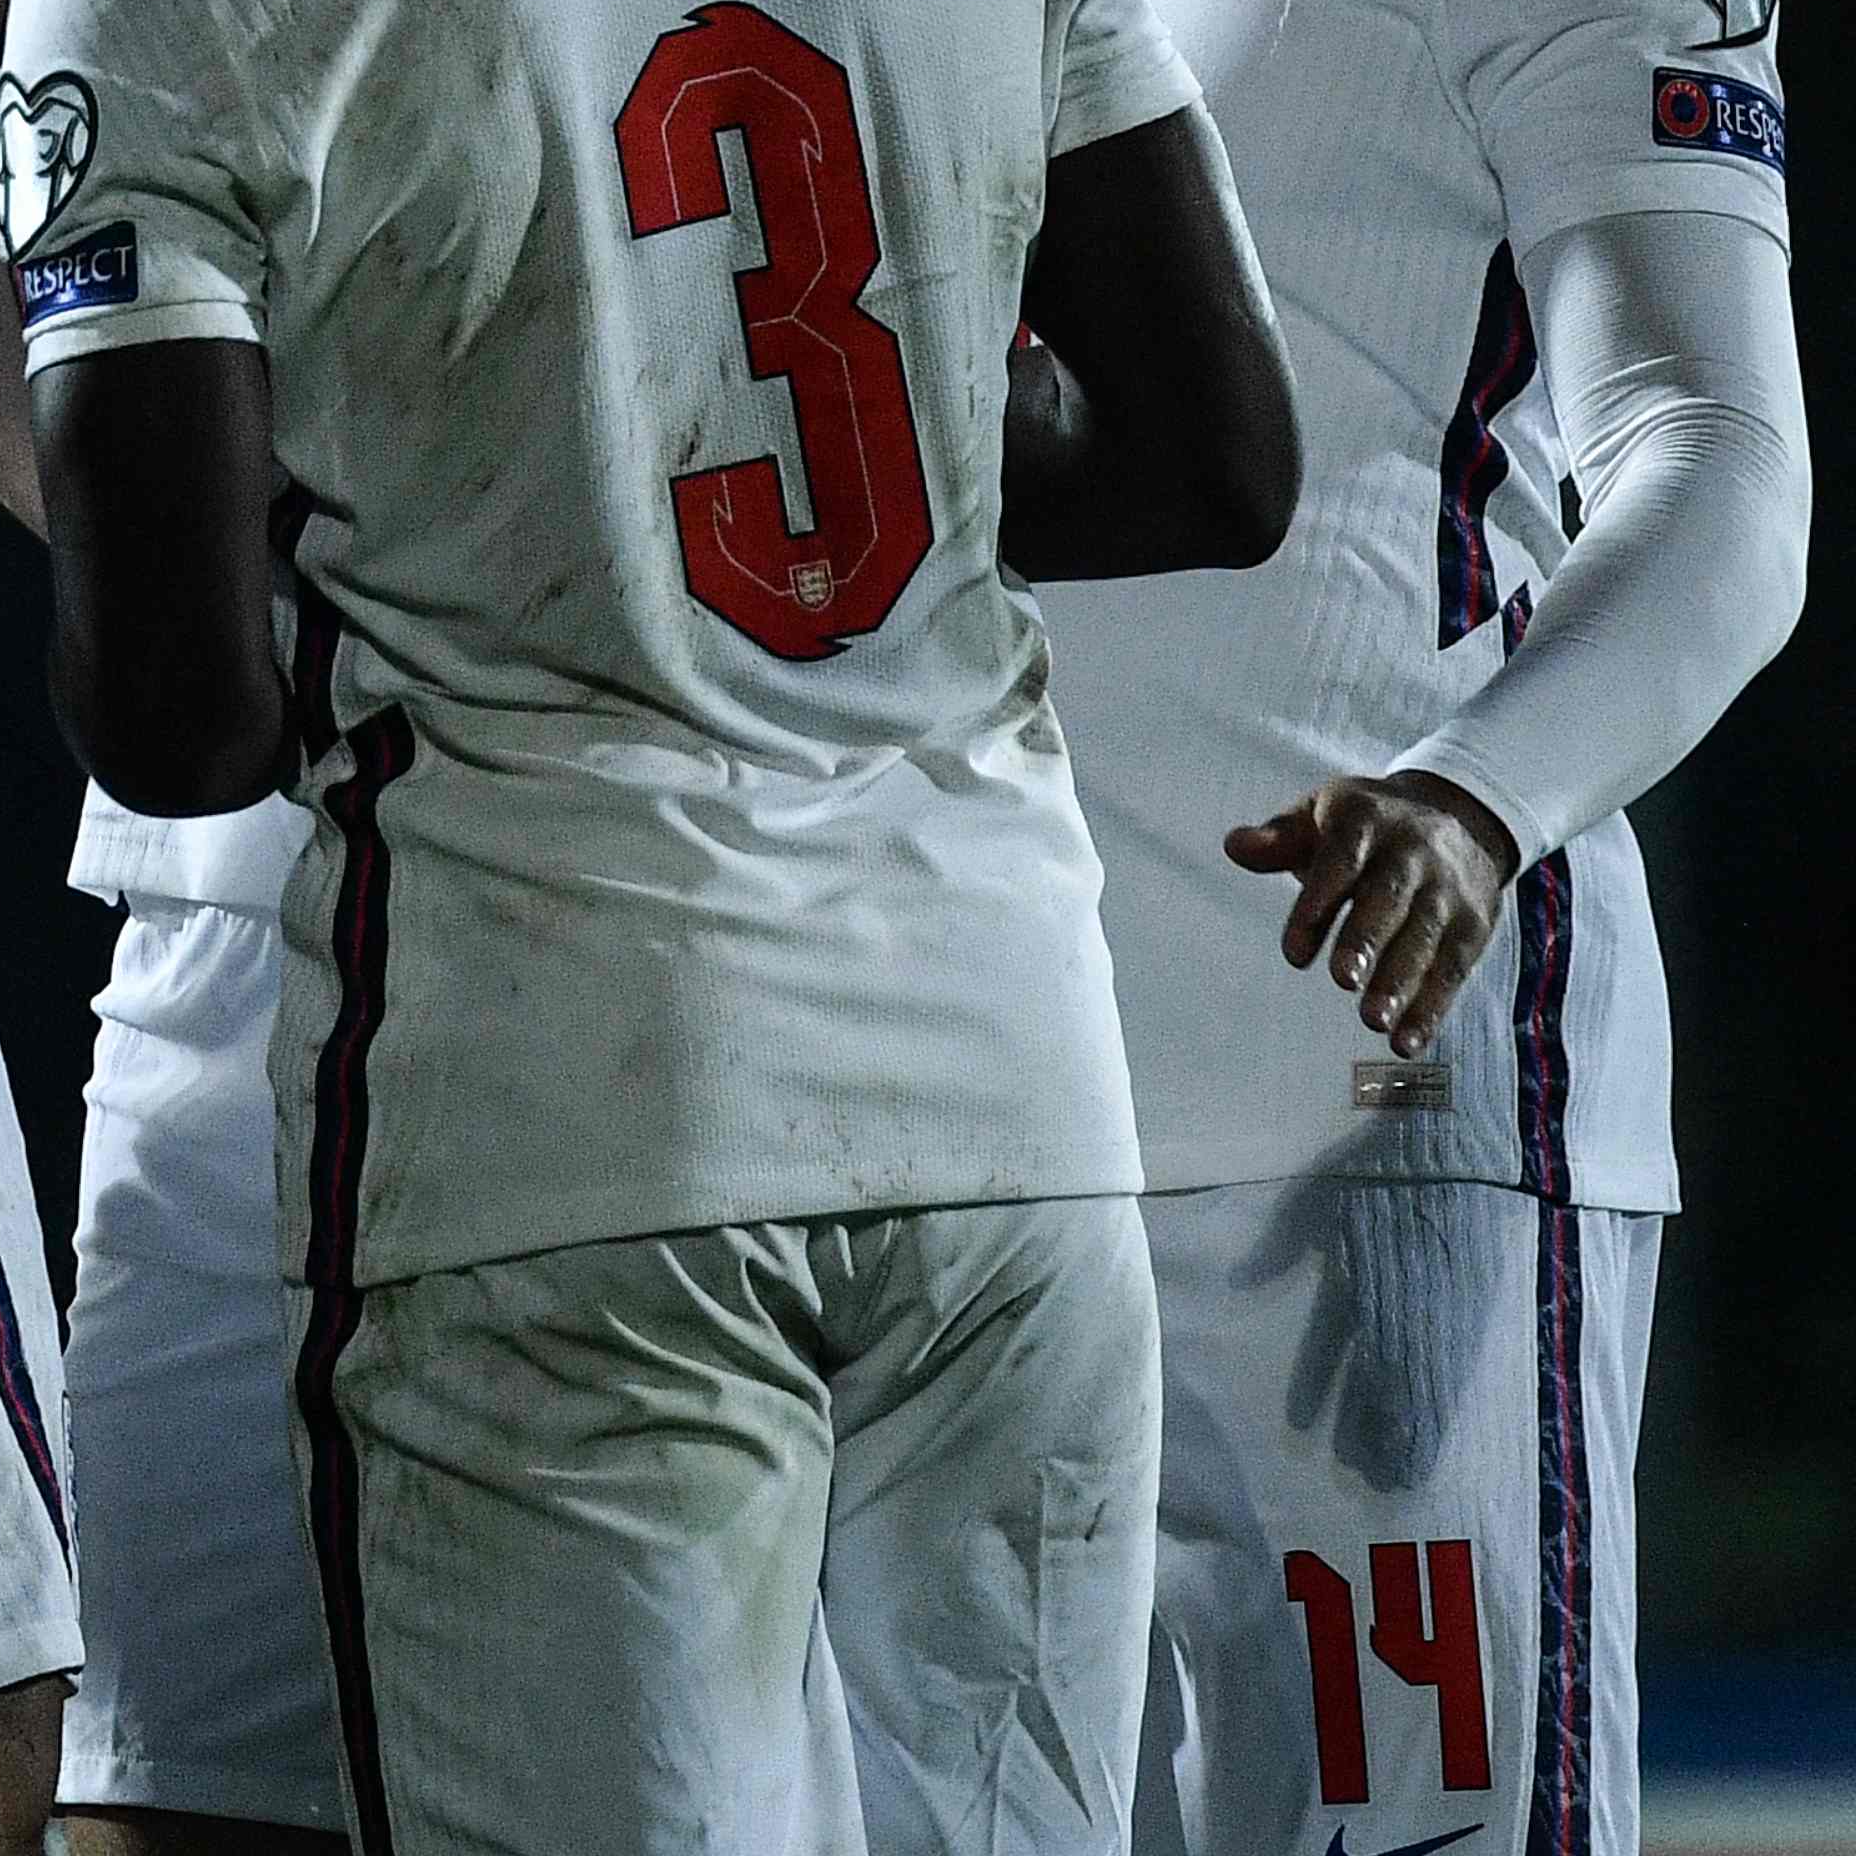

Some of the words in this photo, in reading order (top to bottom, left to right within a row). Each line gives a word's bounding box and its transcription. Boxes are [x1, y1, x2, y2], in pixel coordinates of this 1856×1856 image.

[23, 245, 134, 303] RESPECT
[613, 0, 934, 661] 3
[1282, 1538, 1492, 1805] 14
